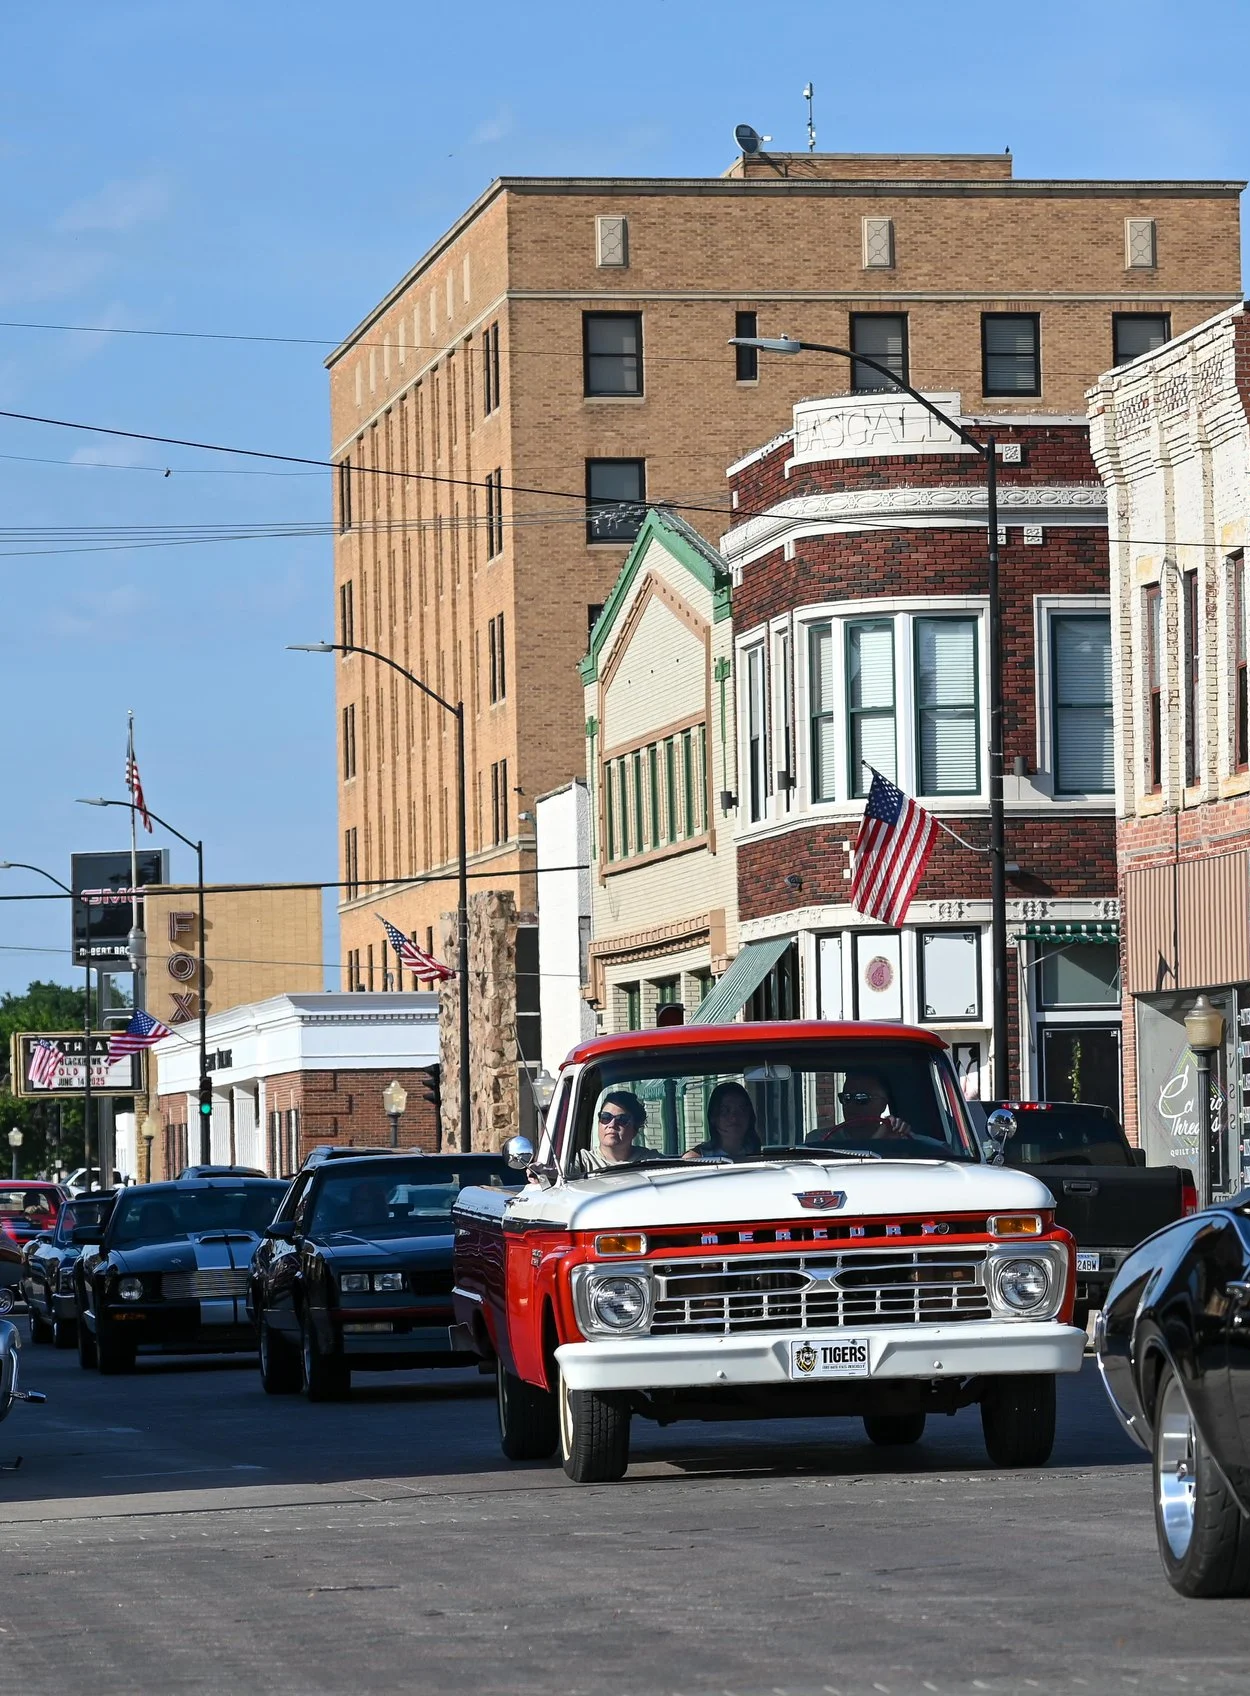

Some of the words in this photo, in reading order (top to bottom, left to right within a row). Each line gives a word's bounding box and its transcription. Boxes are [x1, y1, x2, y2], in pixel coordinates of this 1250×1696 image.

[81, 887, 145, 905] GMC
[79, 946, 112, 956] RBERT
[167, 911, 195, 1023] FOX
[29, 1040, 59, 1054] FX
[60, 1056, 101, 1066] BLACKHWK
[59, 1067, 78, 1076] OLD
[58, 1077, 73, 1086] JUNE
[91, 1077, 105, 1086] 025
[1171, 1115, 1223, 1136] Threa's
[1170, 1148, 1189, 1158] QUILT
[700, 1221, 938, 1245] MERCURY
[1077, 1260, 1097, 1271] 2ABW
[821, 1345, 866, 1364] TIGERS
